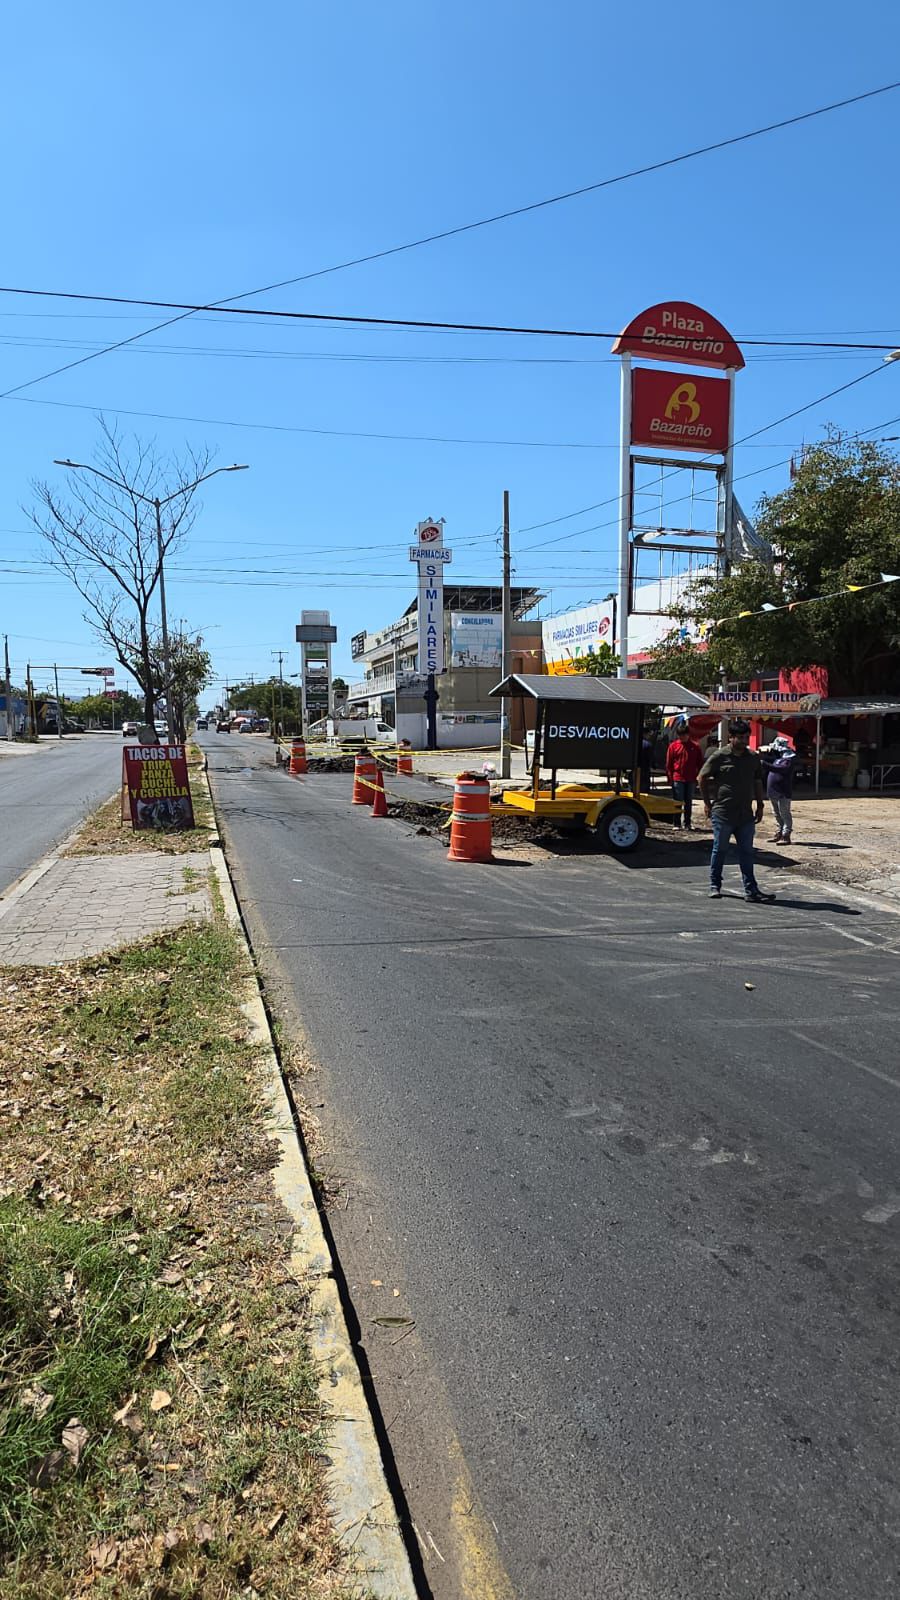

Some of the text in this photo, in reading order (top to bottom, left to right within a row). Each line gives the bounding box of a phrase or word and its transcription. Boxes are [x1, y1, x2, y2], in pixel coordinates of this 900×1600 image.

[662, 311, 704, 333] Plaza
[642, 326, 724, 354] Bazareño
[649, 418, 712, 438] Bazareño
[412, 549, 450, 561] FARMACIAS
[426, 565, 438, 672] SIMILARES
[553, 626, 575, 642] FARMACIAS
[575, 620, 598, 636] SIMILARES
[713, 692, 798, 703] TACOS EL POLLO
[549, 725, 630, 739] DESVIACION
[127, 747, 183, 760] TACOS DE
[143, 760, 172, 770] TRIPA
[142, 769, 174, 779] PANZA
[142, 779, 176, 789] BUCHE
[131, 786, 189, 799] Y COSTILLA
